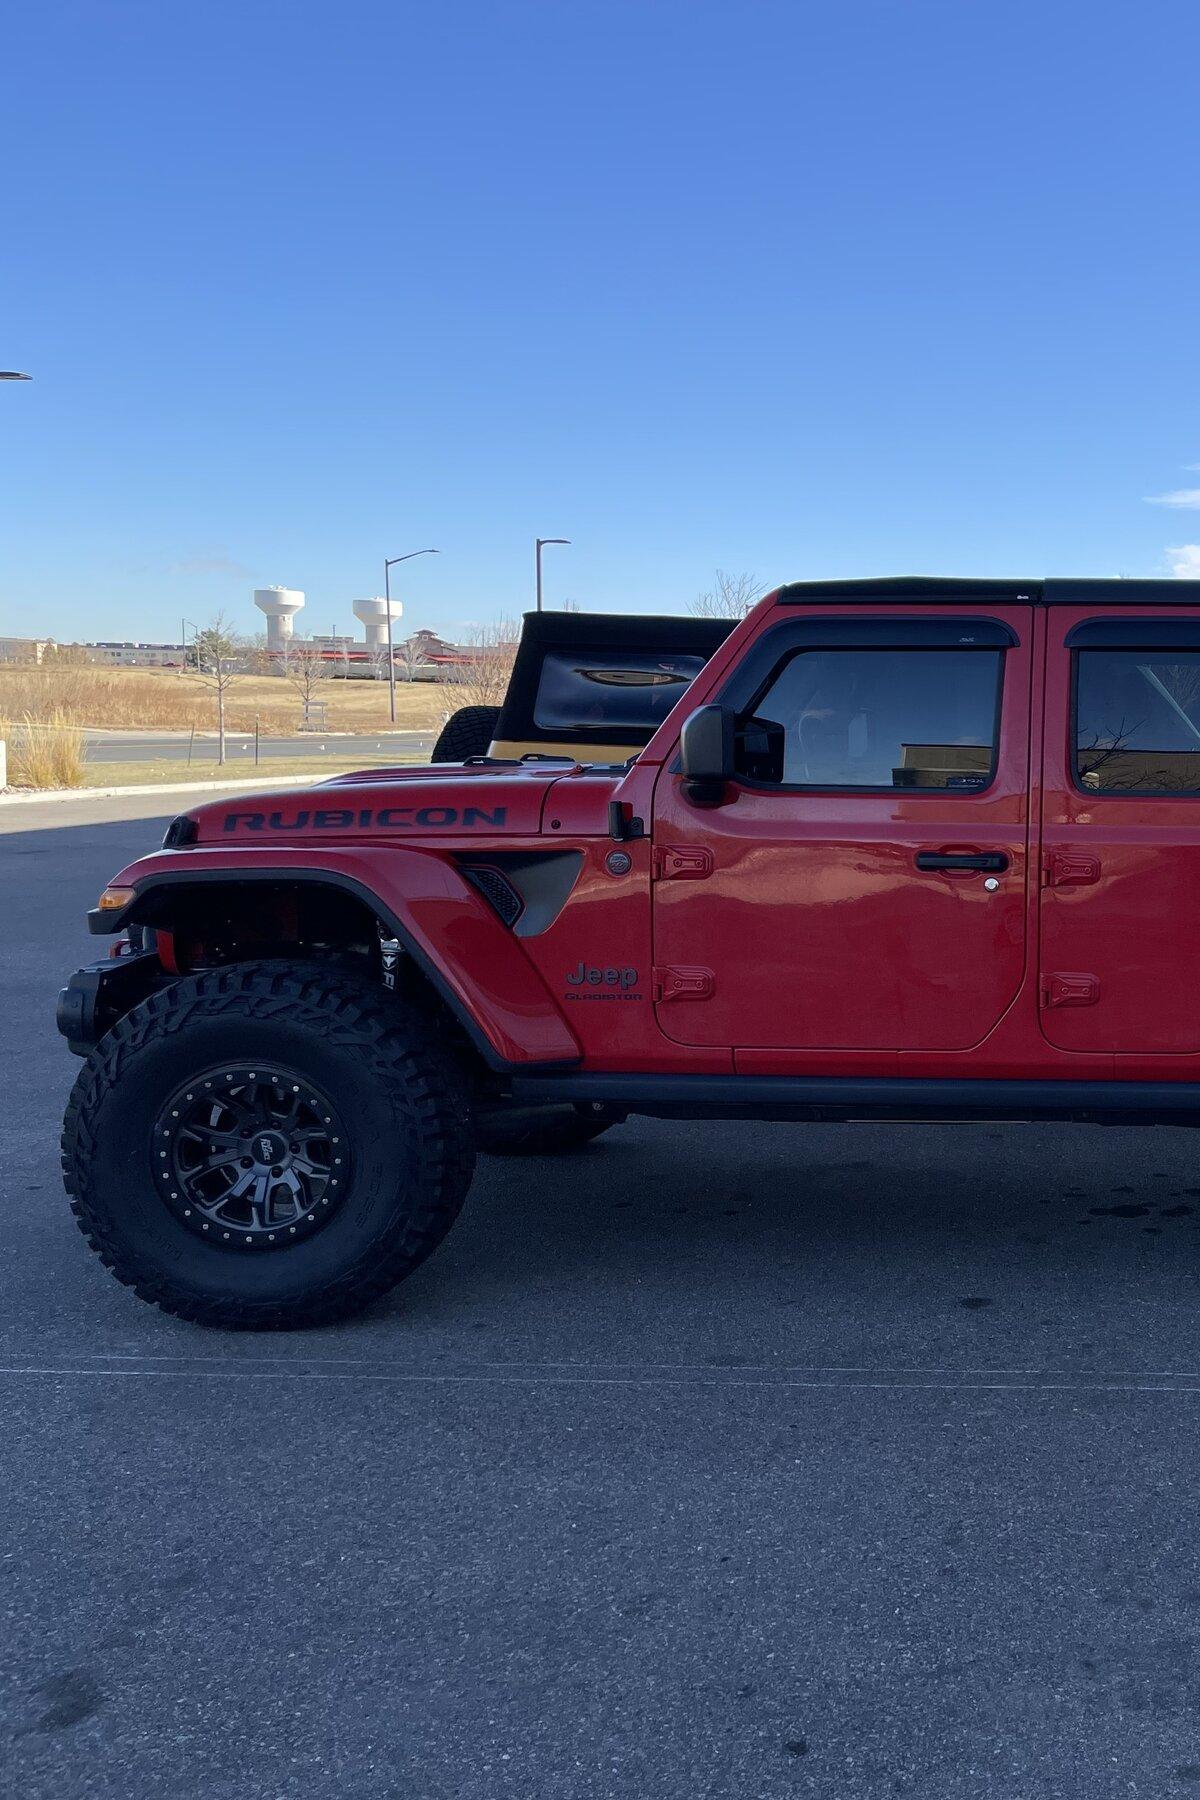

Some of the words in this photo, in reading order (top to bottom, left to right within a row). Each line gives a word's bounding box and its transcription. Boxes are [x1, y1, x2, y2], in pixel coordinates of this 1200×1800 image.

[223, 806, 508, 832] RUBICON
[566, 961, 638, 990] Jeep
[564, 992, 642, 1001] GLADIATOR
